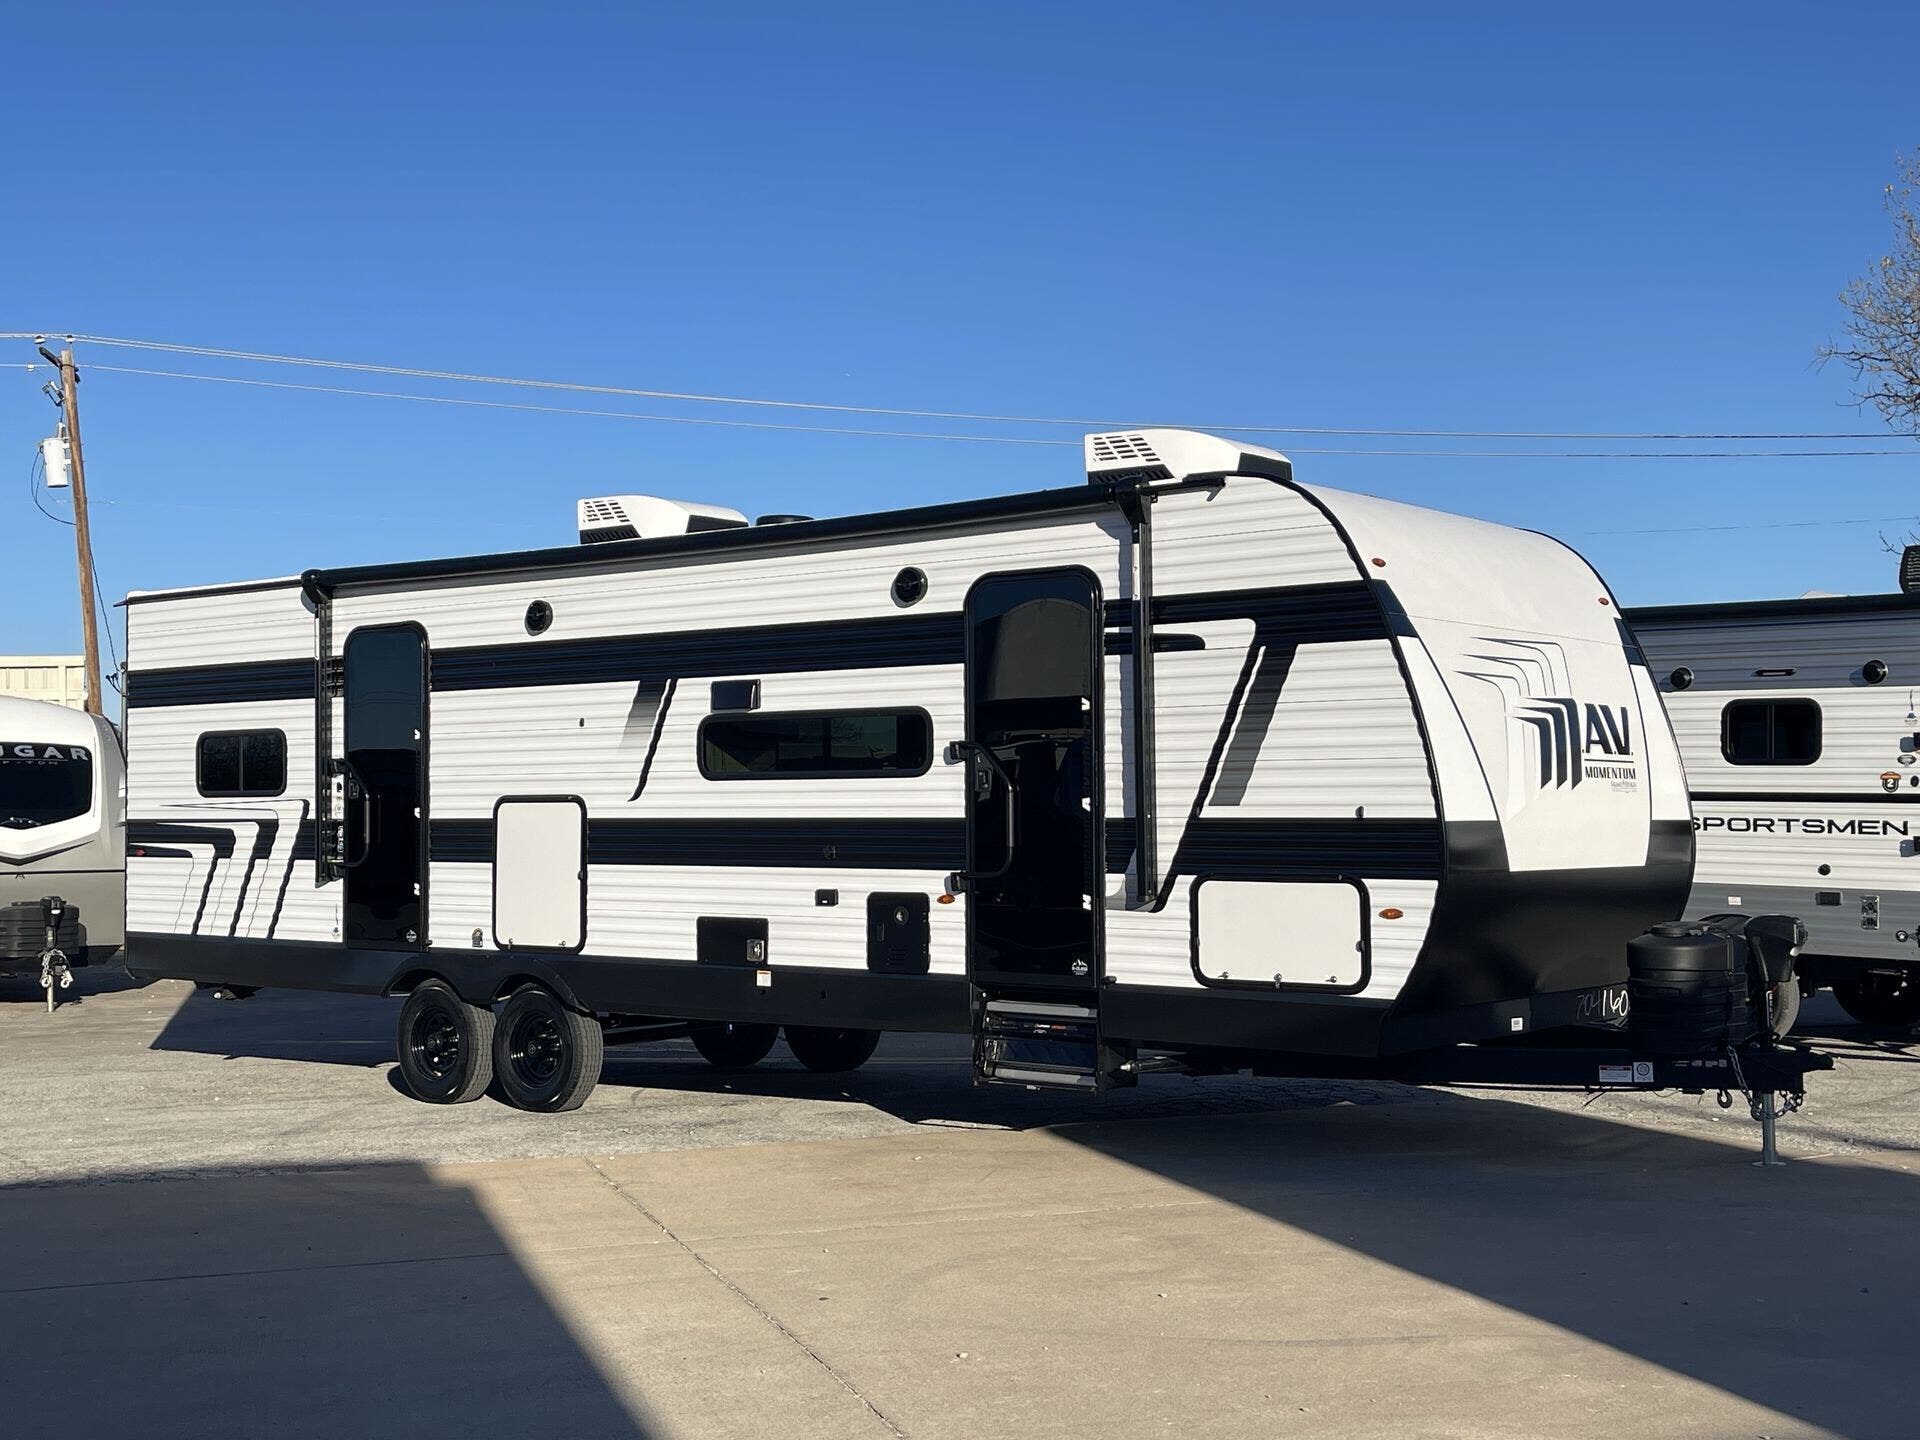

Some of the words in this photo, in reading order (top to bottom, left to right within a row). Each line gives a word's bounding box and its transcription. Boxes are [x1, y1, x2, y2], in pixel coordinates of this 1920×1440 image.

[0, 745, 88, 760] GAR
[1585, 766, 1637, 780] MOMENTUM
[1886, 779, 1895, 788] 2
